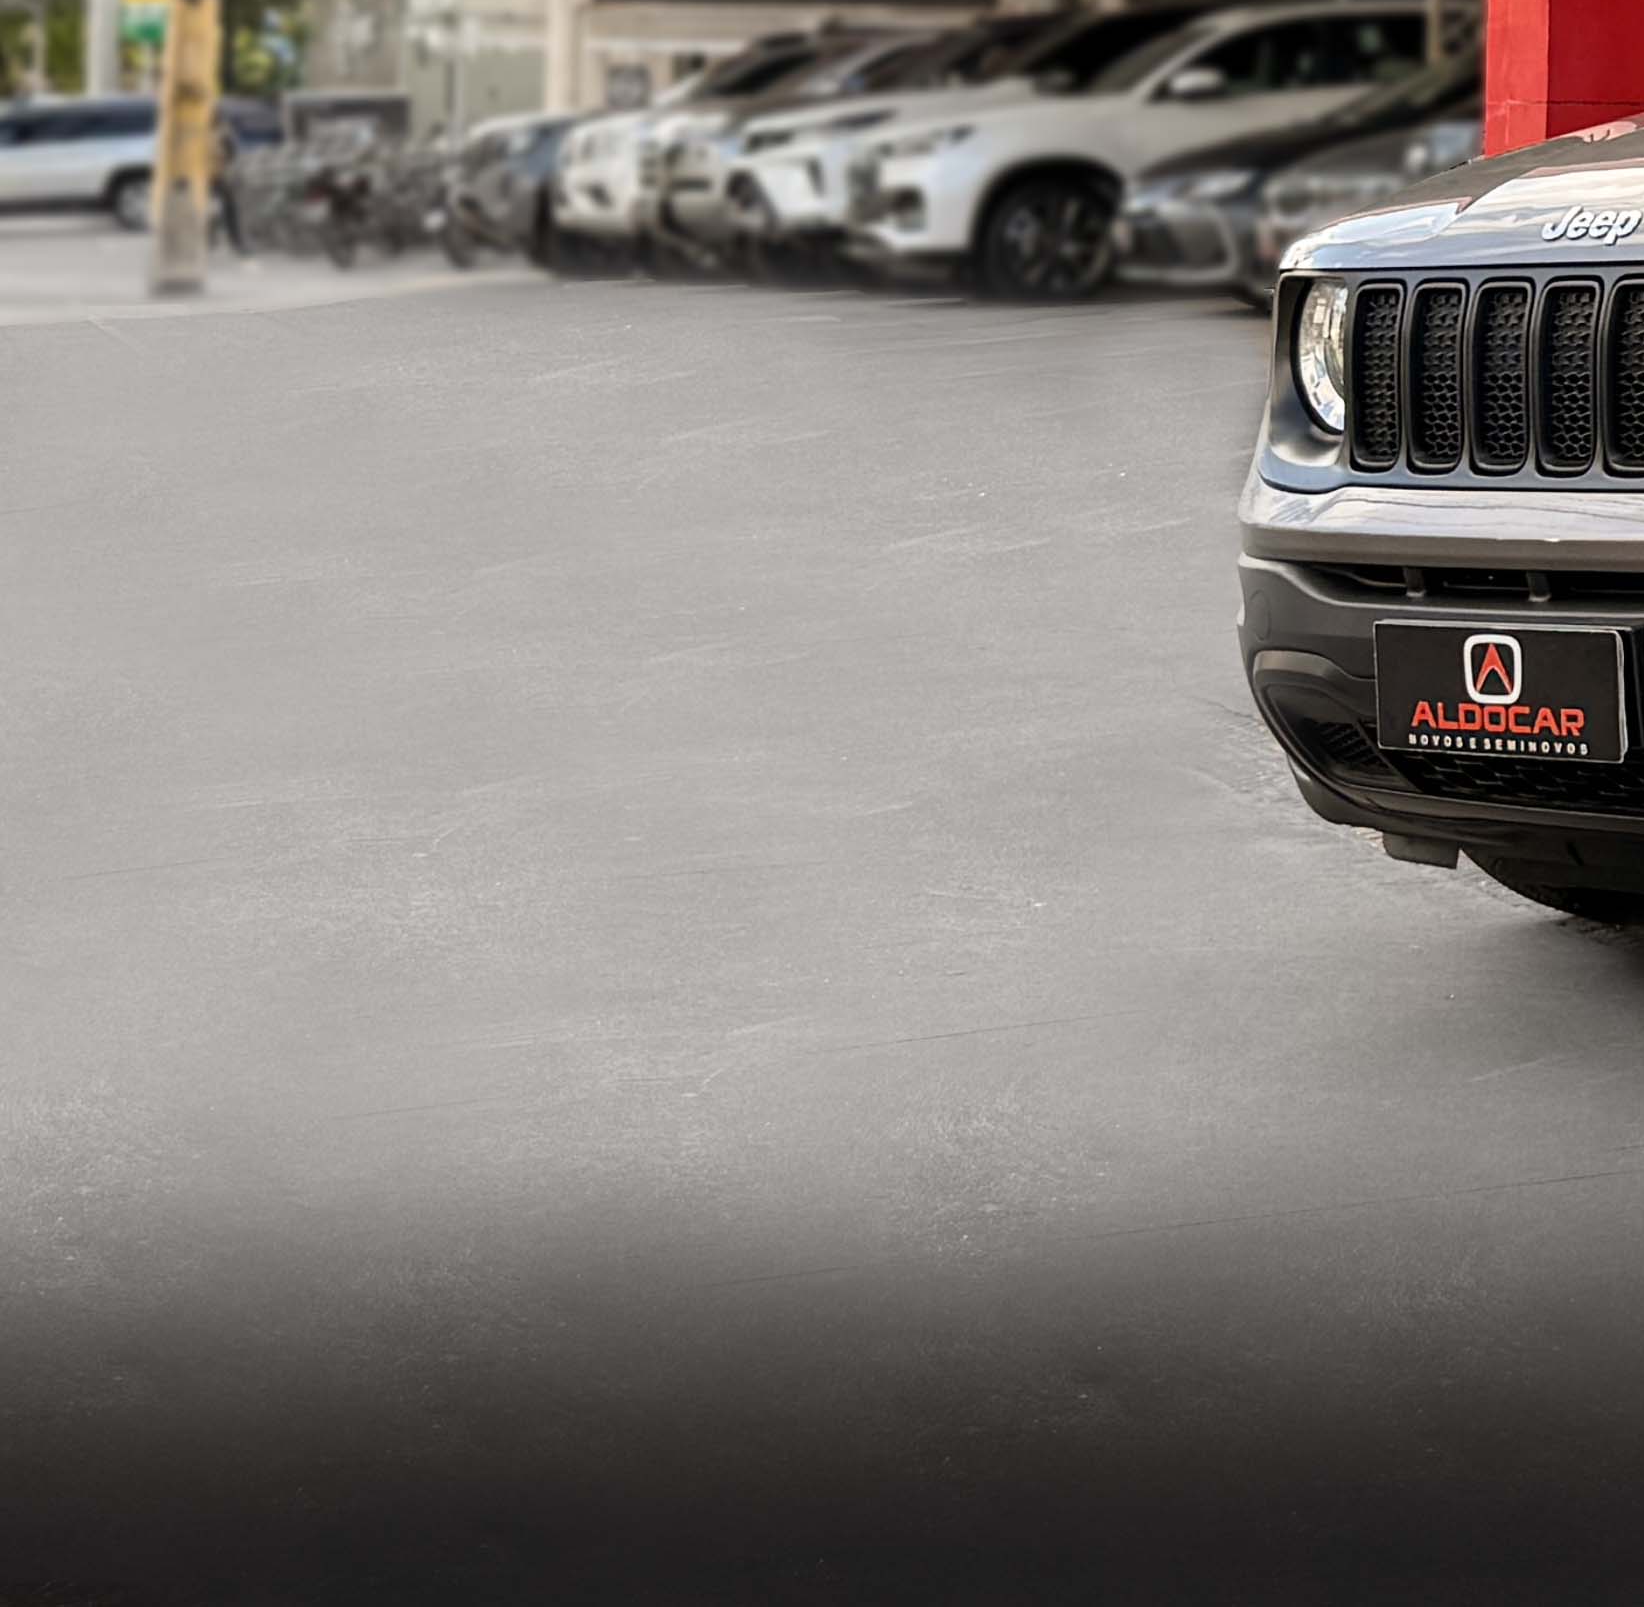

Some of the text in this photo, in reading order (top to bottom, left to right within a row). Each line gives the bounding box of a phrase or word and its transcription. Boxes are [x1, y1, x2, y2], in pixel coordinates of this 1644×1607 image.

[1541, 205, 1644, 247] Jeep
[1410, 700, 1586, 736] ALDOCAR
[1408, 733, 1590, 756] NOVOS E SEMINOVOS
